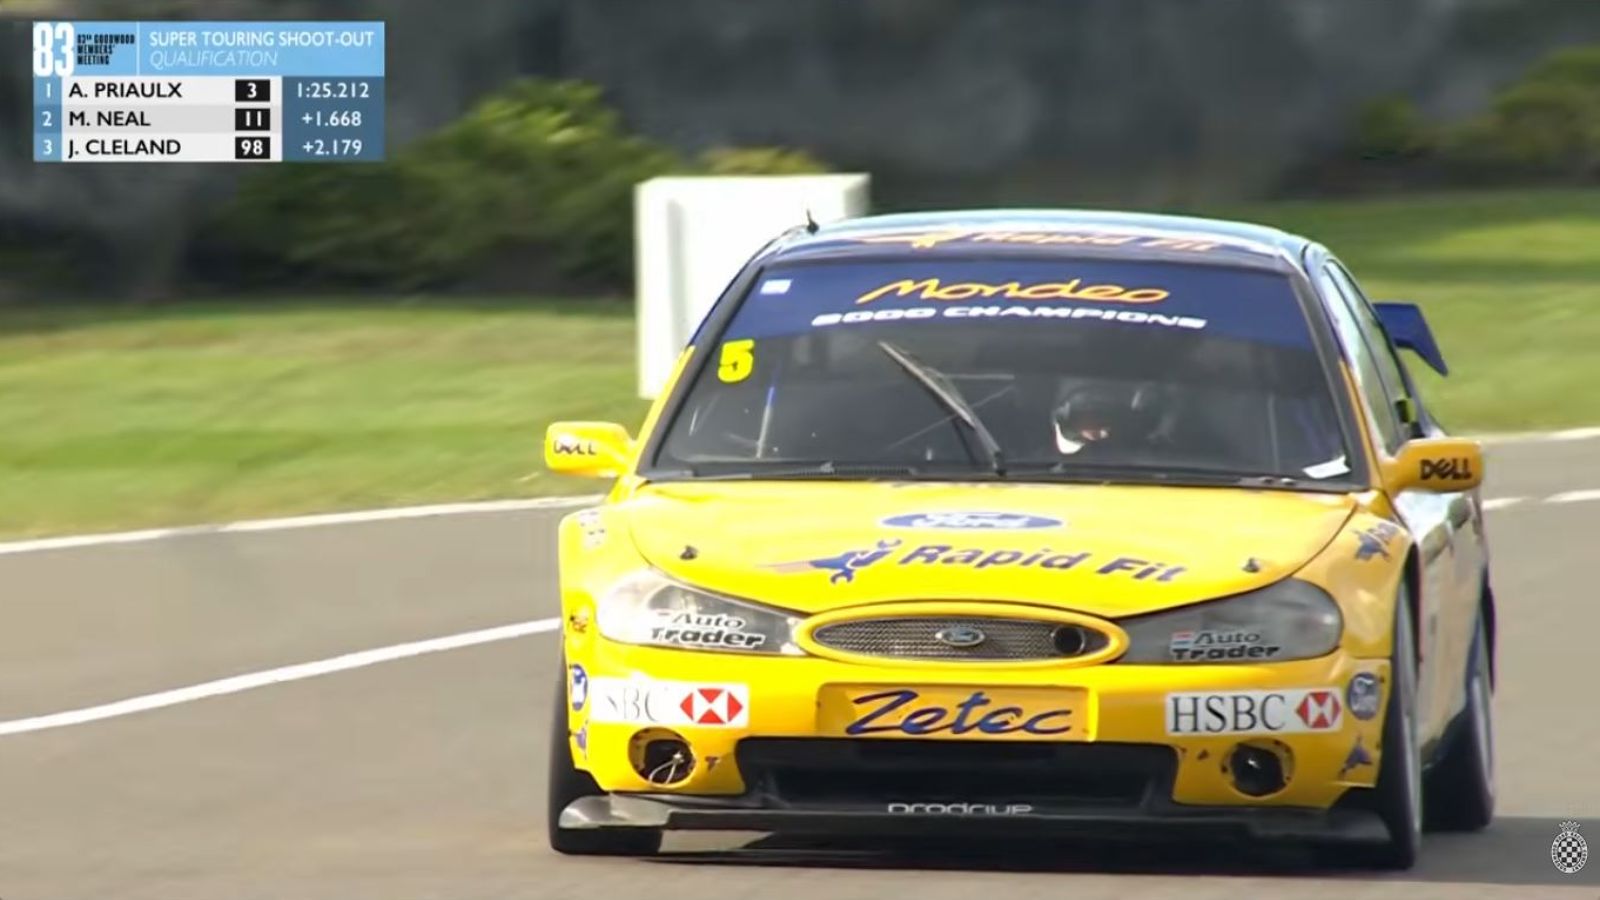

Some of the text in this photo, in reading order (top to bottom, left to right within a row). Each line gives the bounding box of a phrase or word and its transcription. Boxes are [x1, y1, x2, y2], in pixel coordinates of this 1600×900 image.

[856, 278, 1170, 304] Mondeo
[943, 302, 1207, 330] CHAMPIONS
[717, 338, 754, 384] 5
[1419, 457, 1473, 481] DELL
[898, 543, 1187, 582] Rapid Fit
[671, 613, 744, 629] Auto
[650, 626, 764, 647] Trader
[1193, 631, 1262, 645] Auto
[1171, 643, 1282, 661] Trader
[845, 689, 1073, 736] Zetec
[1170, 693, 1287, 733] HSBC
